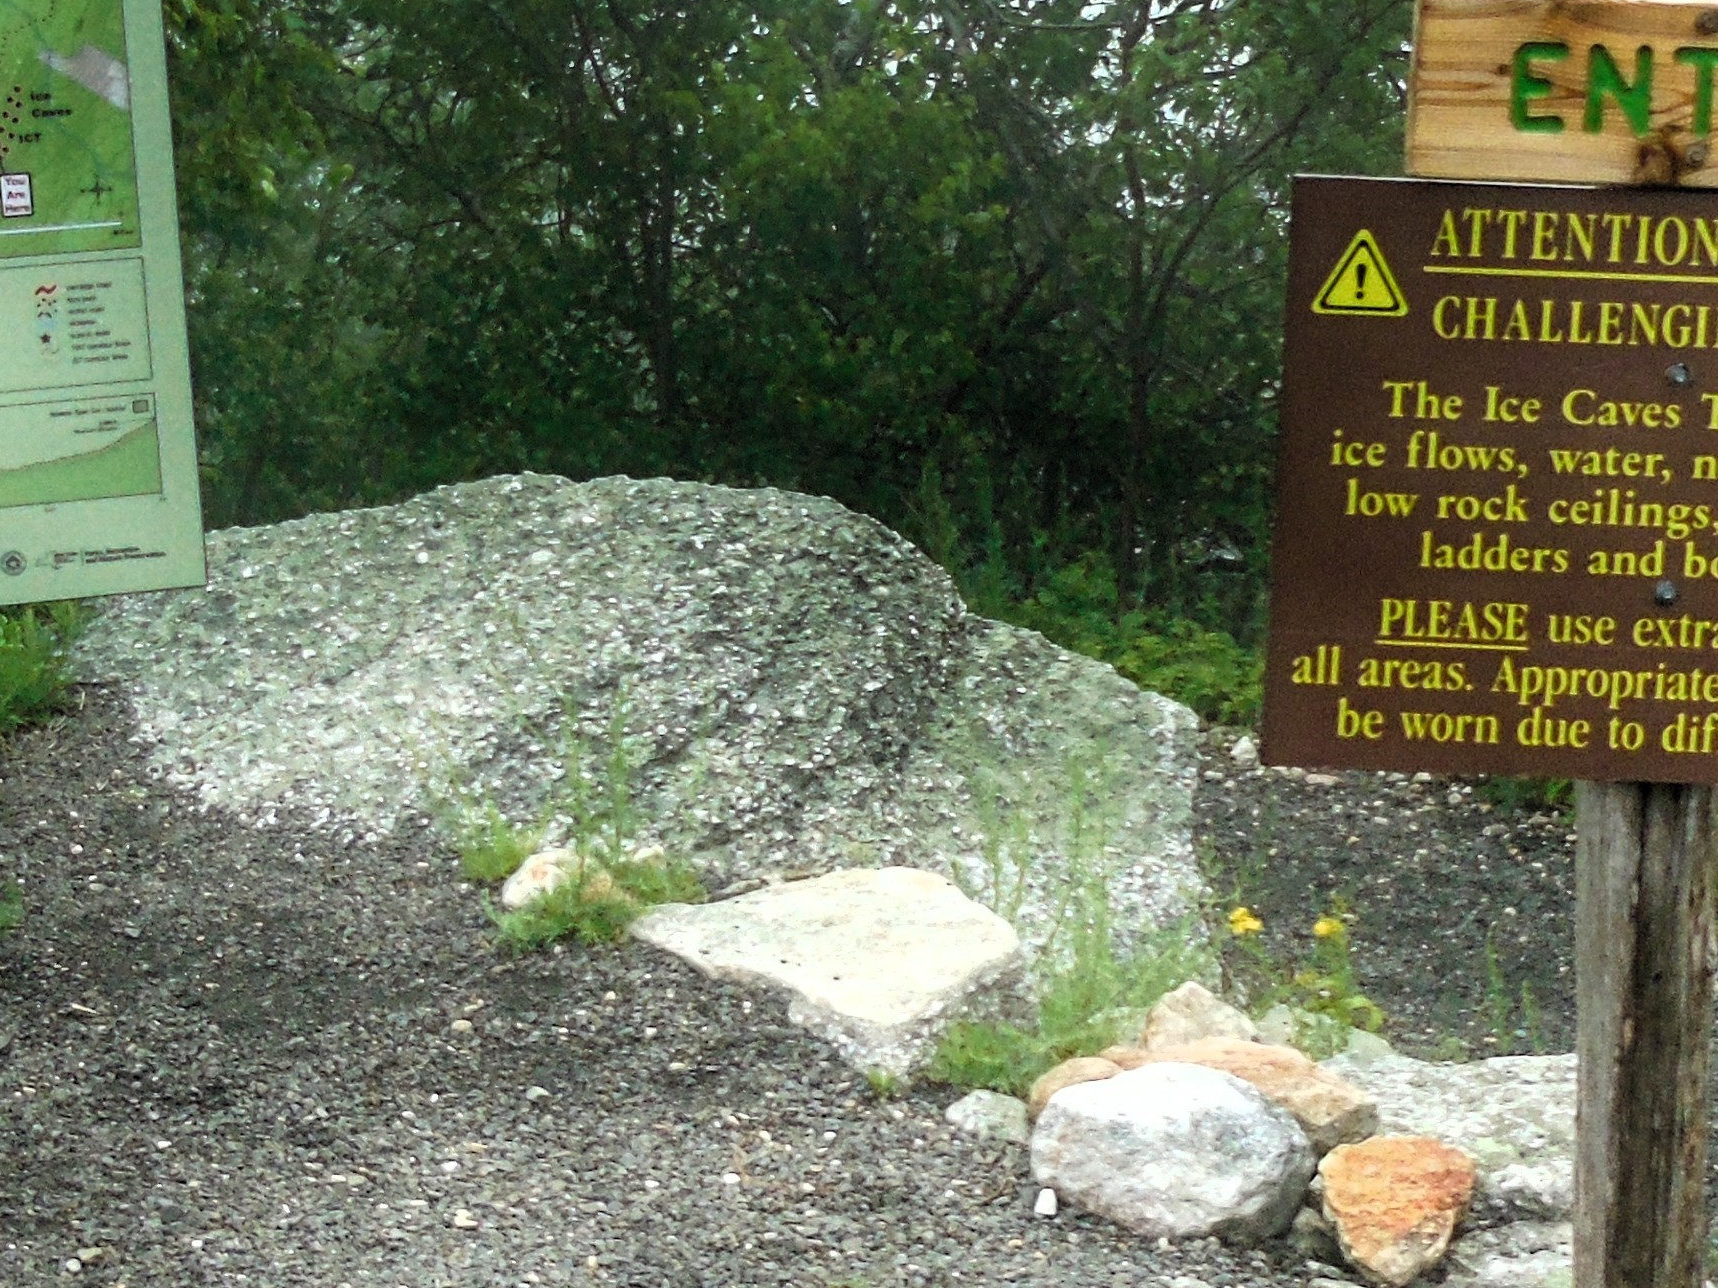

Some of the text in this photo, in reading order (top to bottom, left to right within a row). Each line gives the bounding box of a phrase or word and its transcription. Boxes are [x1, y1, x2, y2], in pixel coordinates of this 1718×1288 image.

[30, 91, 50, 102] Ice
[31, 106, 72, 119] Caves
[4, 176, 26, 186] You
[6, 190, 26, 200] Are
[1383, 380, 1463, 420] The
[1485, 385, 1542, 423] Ice
[1562, 389, 1681, 428] Caves
[1331, 429, 1386, 467] ice
[1407, 430, 1528, 478] flows,
[1550, 447, 1673, 483] water,
[1346, 477, 1418, 516] low
[1437, 483, 1529, 522] rock
[1420, 530, 1569, 573] ladders
[1587, 537, 1665, 578] and
[1379, 598, 1529, 641] PLEASE
[1548, 614, 1617, 645] use
[1291, 644, 1341, 687] all
[1358, 658, 1473, 691] areas.
[1337, 697, 1384, 739] be
[1401, 712, 1499, 744] worn
[1516, 705, 1591, 748] due
[1609, 708, 1645, 750] to
